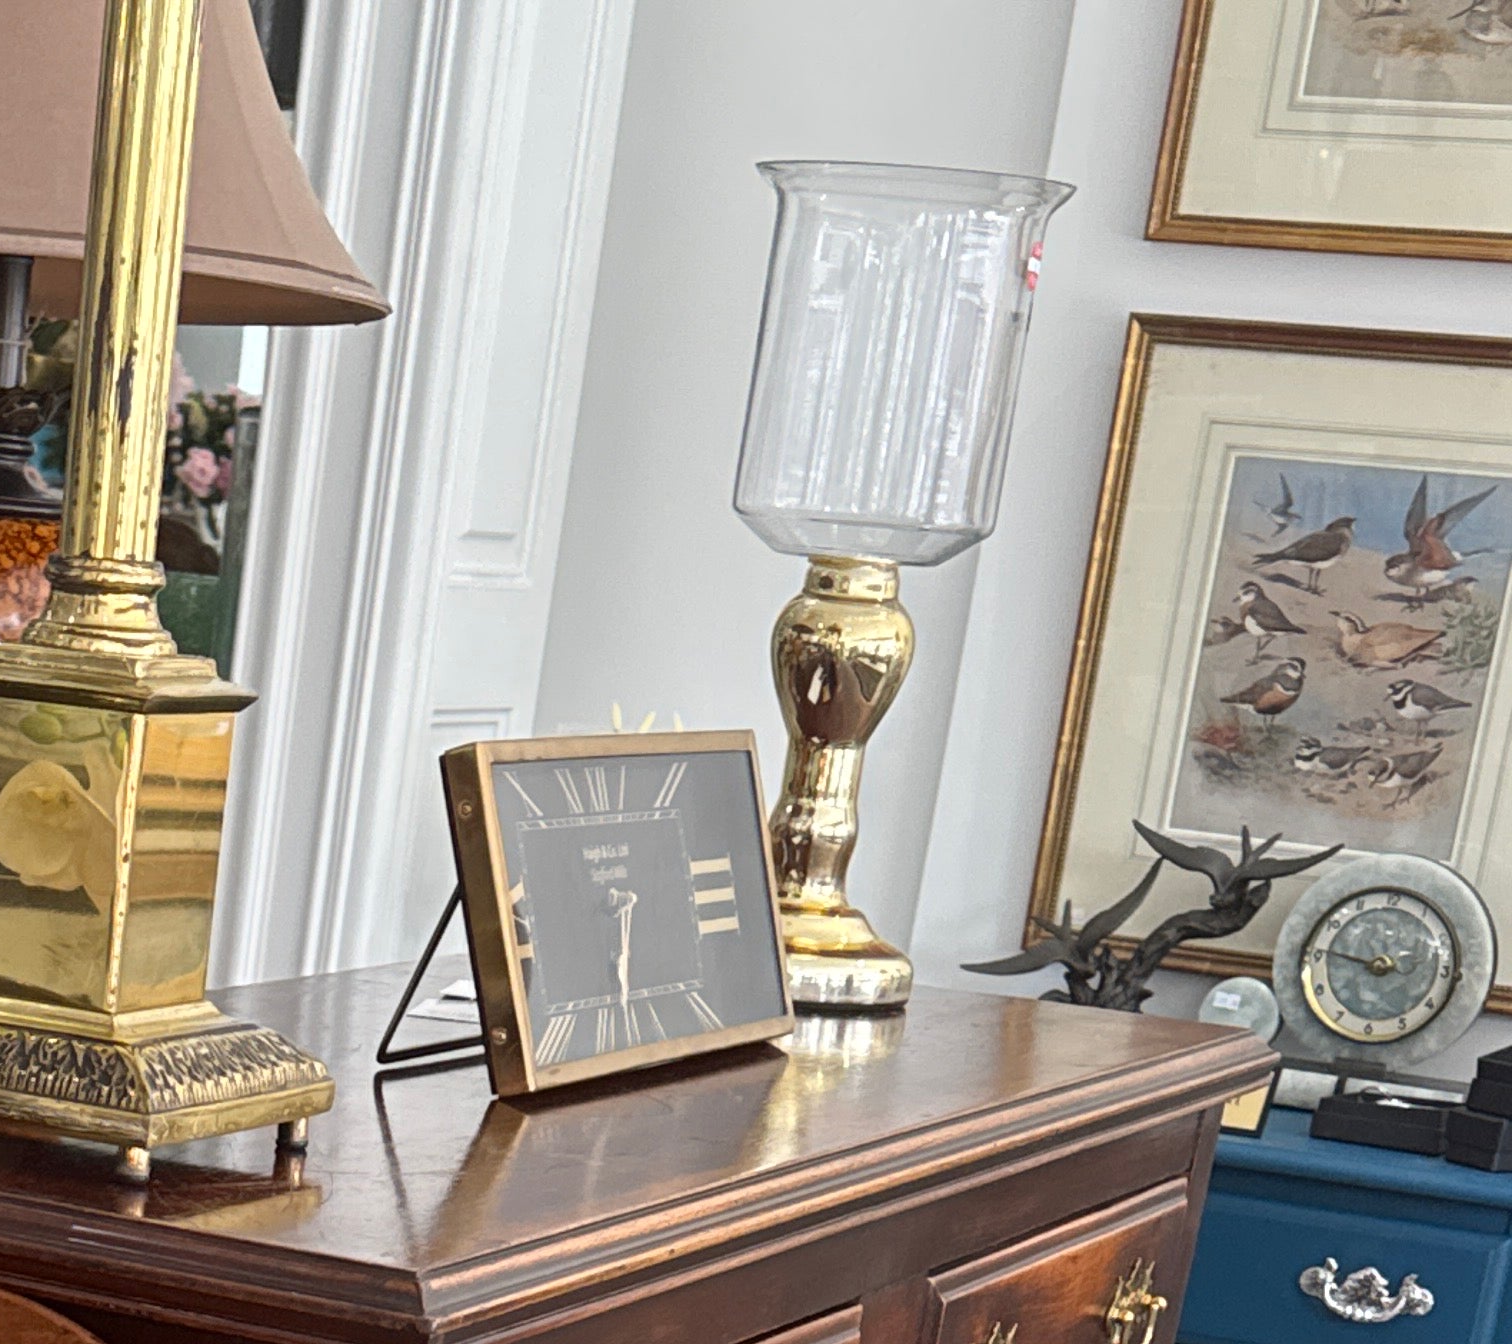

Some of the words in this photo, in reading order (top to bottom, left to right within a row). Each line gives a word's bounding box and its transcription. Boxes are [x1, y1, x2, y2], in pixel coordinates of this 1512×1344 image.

[1387, 893, 1401, 907] 12
[1440, 965, 1450, 979] 3
[1424, 996, 1435, 1010] 4
[1363, 1022, 1374, 1035] 6
[1397, 1017, 1407, 1030] 5
